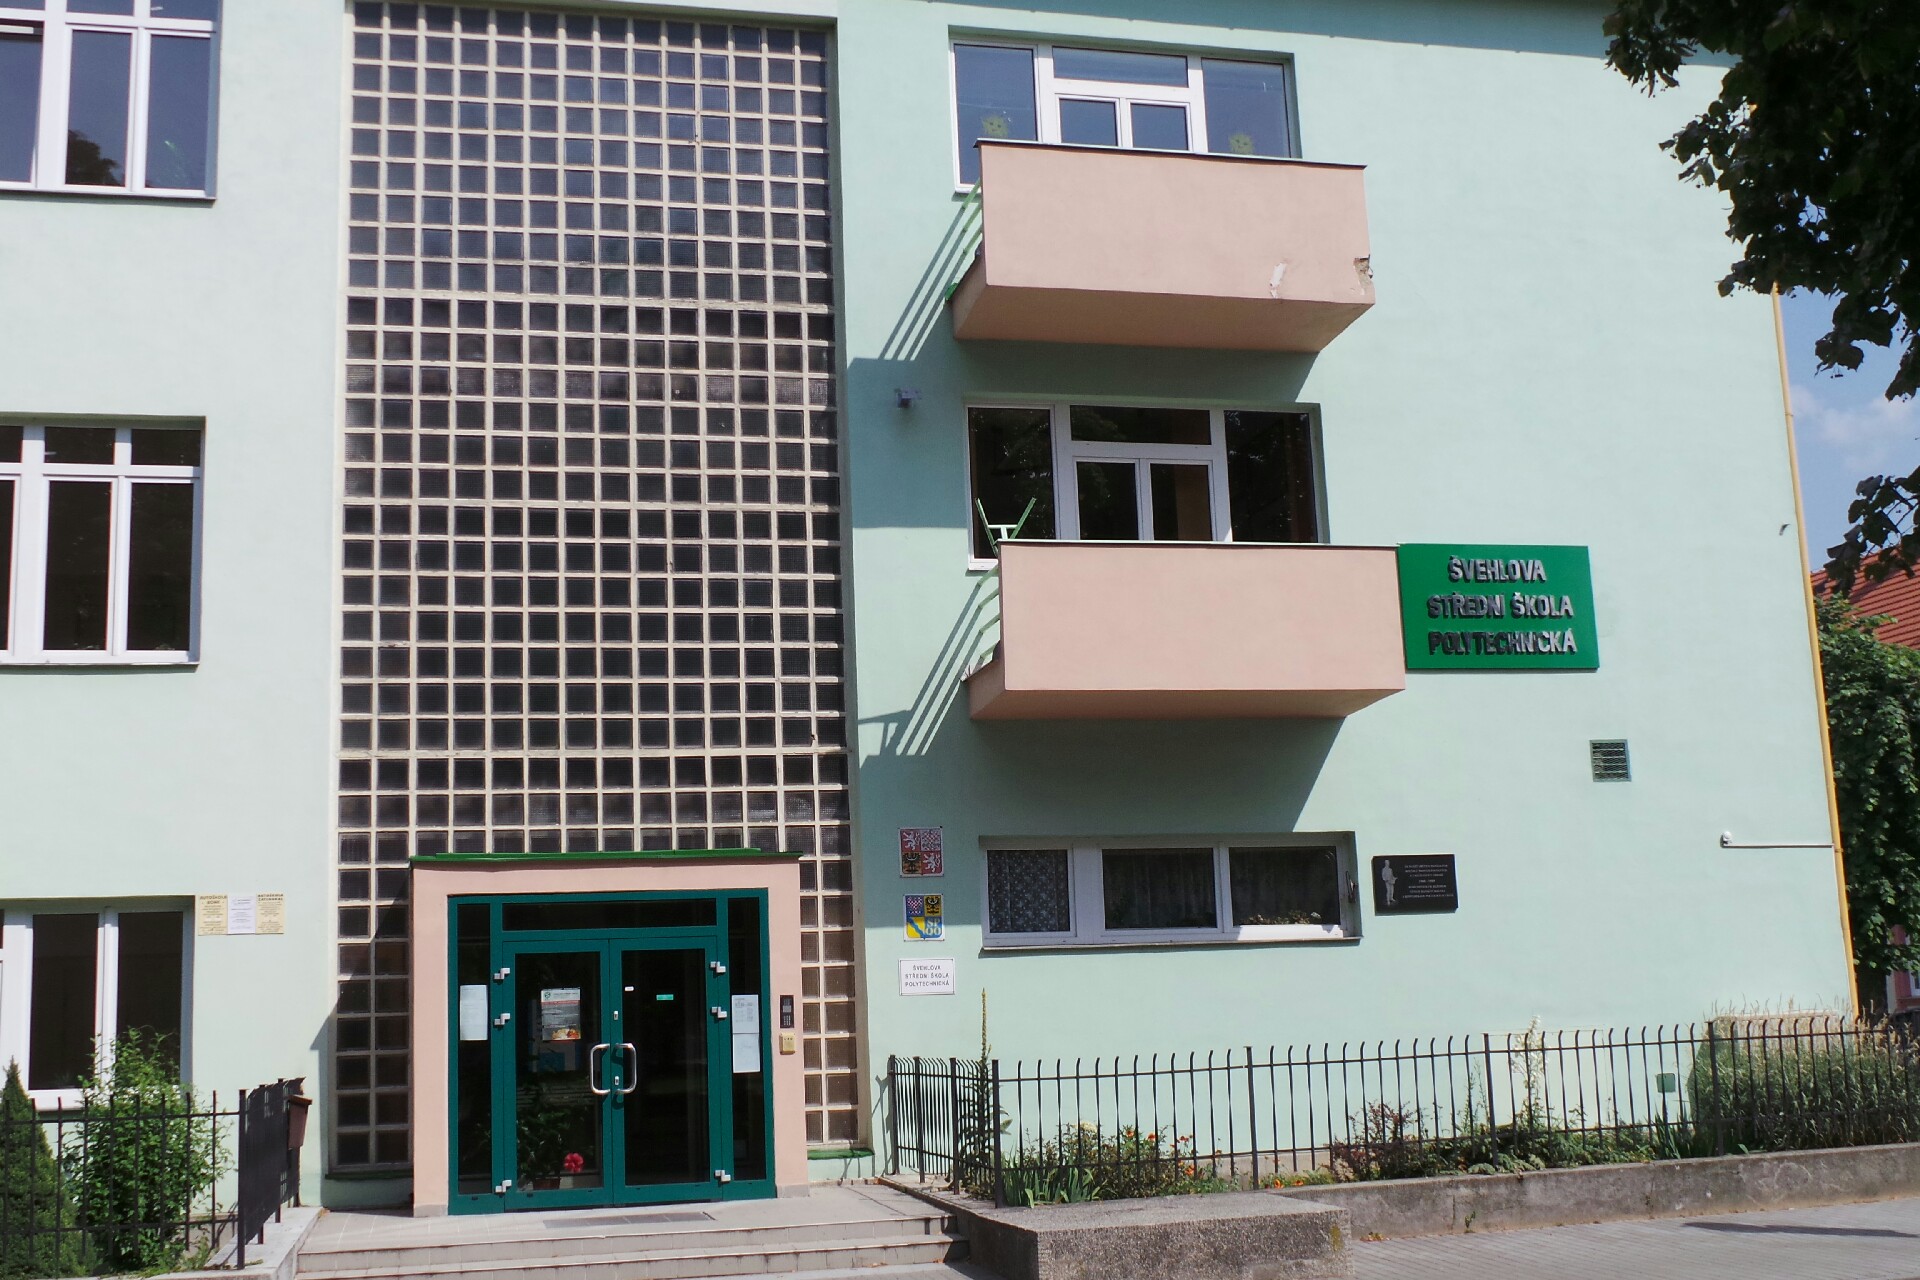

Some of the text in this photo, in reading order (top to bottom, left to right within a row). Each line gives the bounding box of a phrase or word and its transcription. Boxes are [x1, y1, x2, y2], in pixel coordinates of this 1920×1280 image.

[1448, 555, 1547, 583] ŠVEHLOVA
[1511, 592, 1574, 618] ŠKOLA
[1428, 628, 1578, 655] POLYTECHNICKÁ
